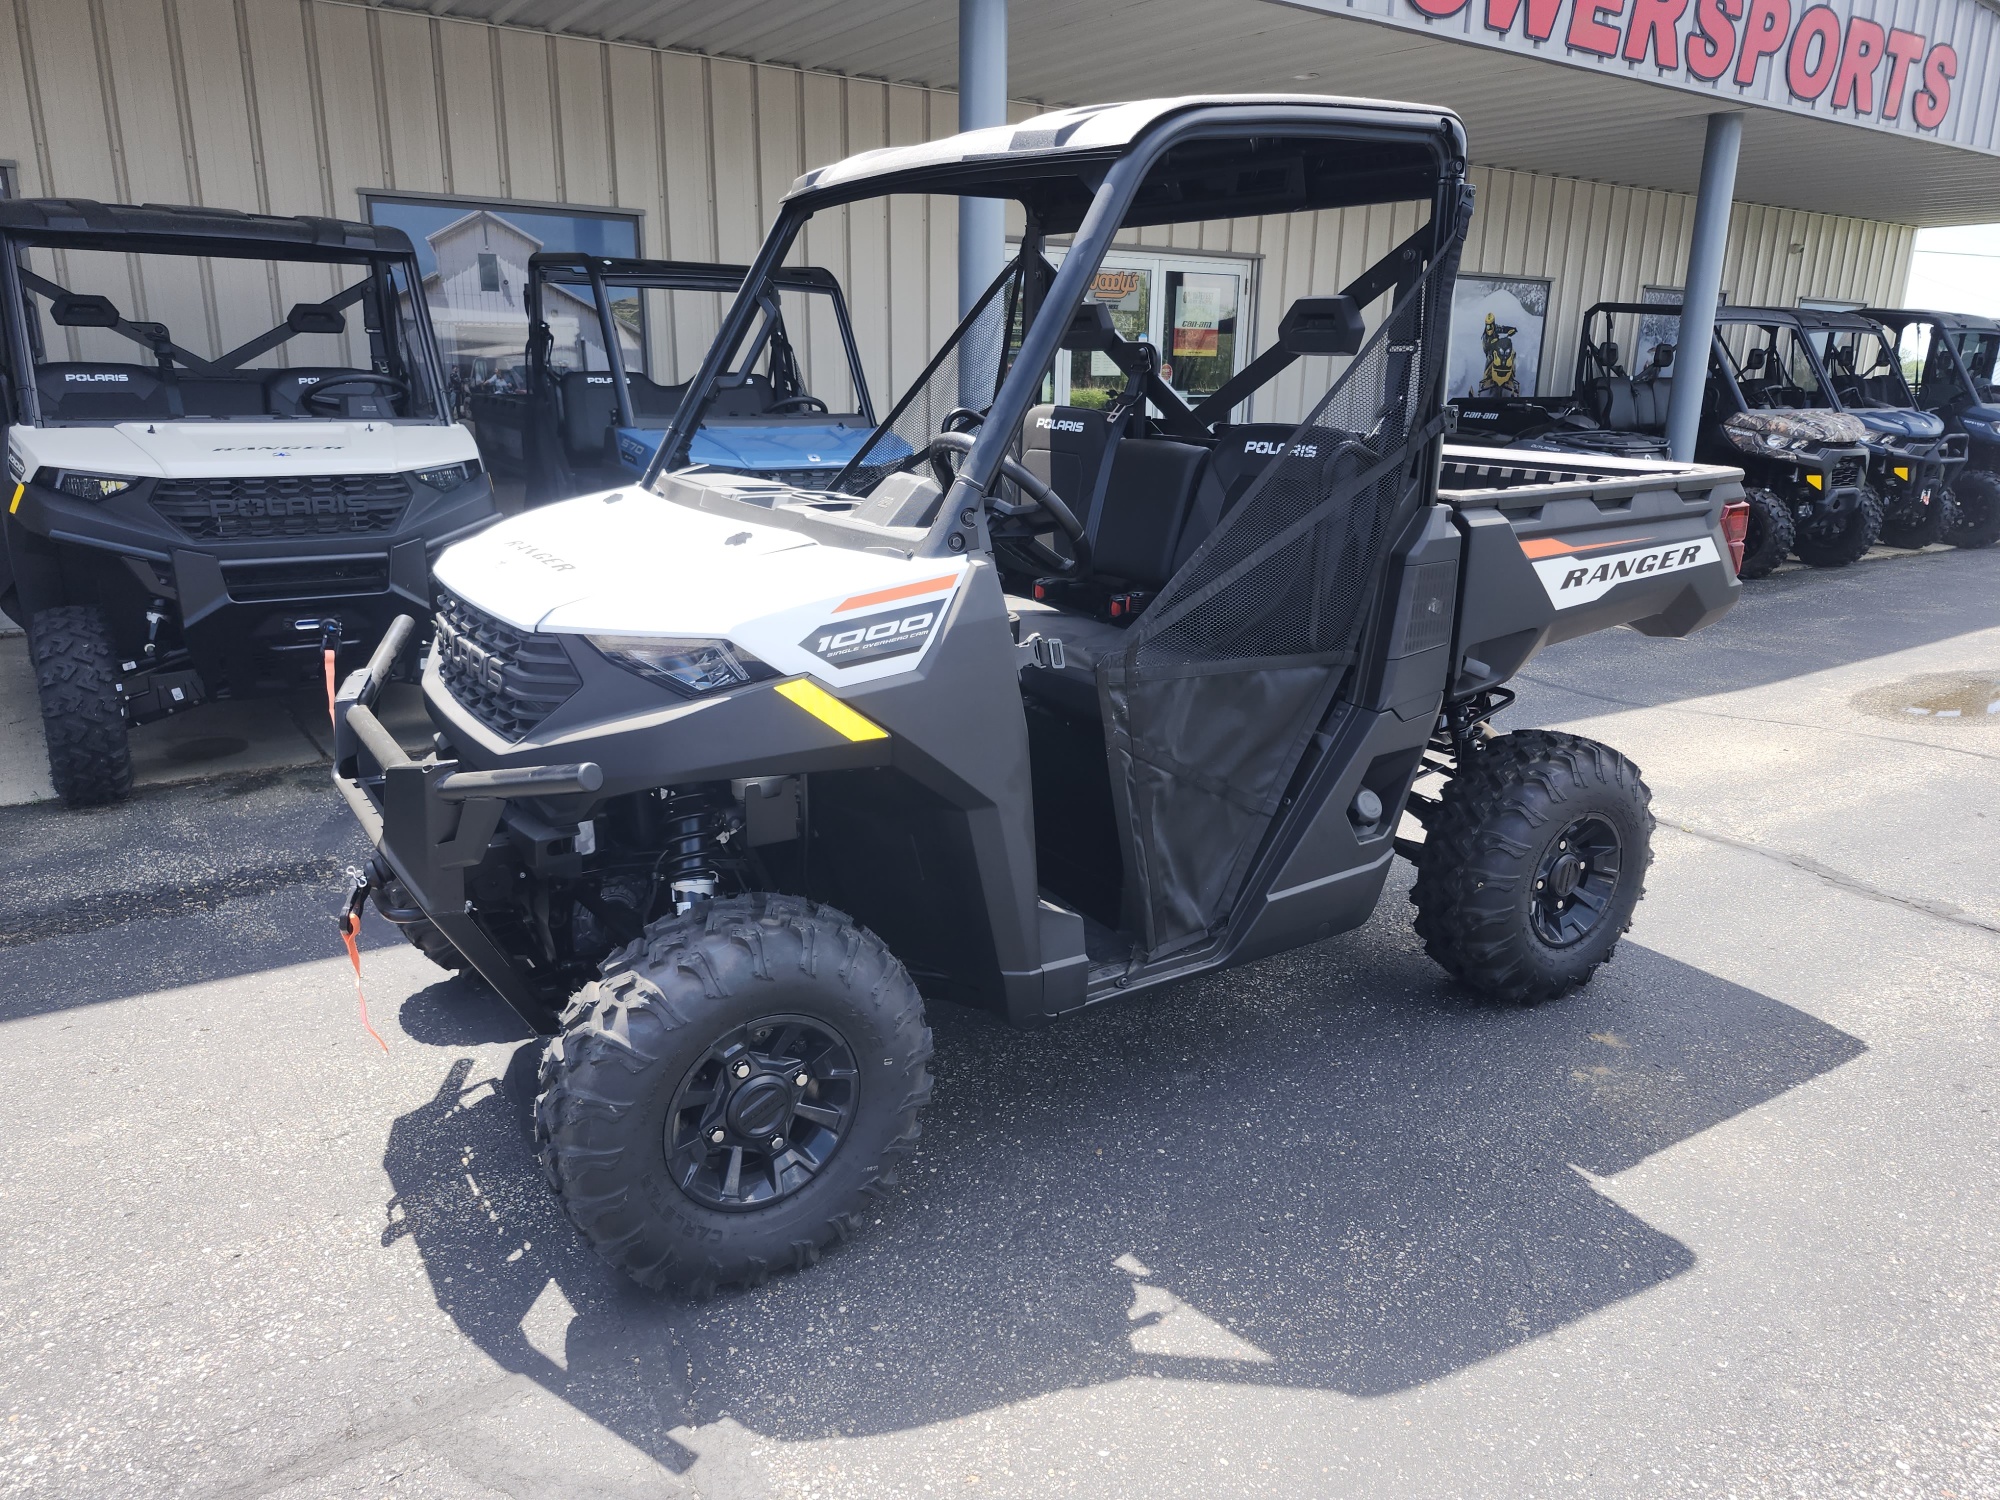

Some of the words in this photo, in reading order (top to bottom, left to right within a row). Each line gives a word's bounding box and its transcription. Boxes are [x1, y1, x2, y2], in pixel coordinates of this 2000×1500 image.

[1409, 0, 1957, 131] ERSPORTS
[1181, 320, 1212, 328] can-am
[65, 373, 129, 382] POLARIS
[586, 377, 631, 385] POLAS
[1463, 411, 1499, 420] can-am
[1036, 417, 1085, 433] POLARIS
[621, 438, 645, 455] 570
[209, 493, 370, 518] POLARIS
[1560, 545, 1702, 590] RANGER
[816, 612, 934, 653] 1000
[826, 646, 860, 658] SINGLE
[863, 634, 908, 650] OVERHEAD
[910, 629, 930, 639] CAM
